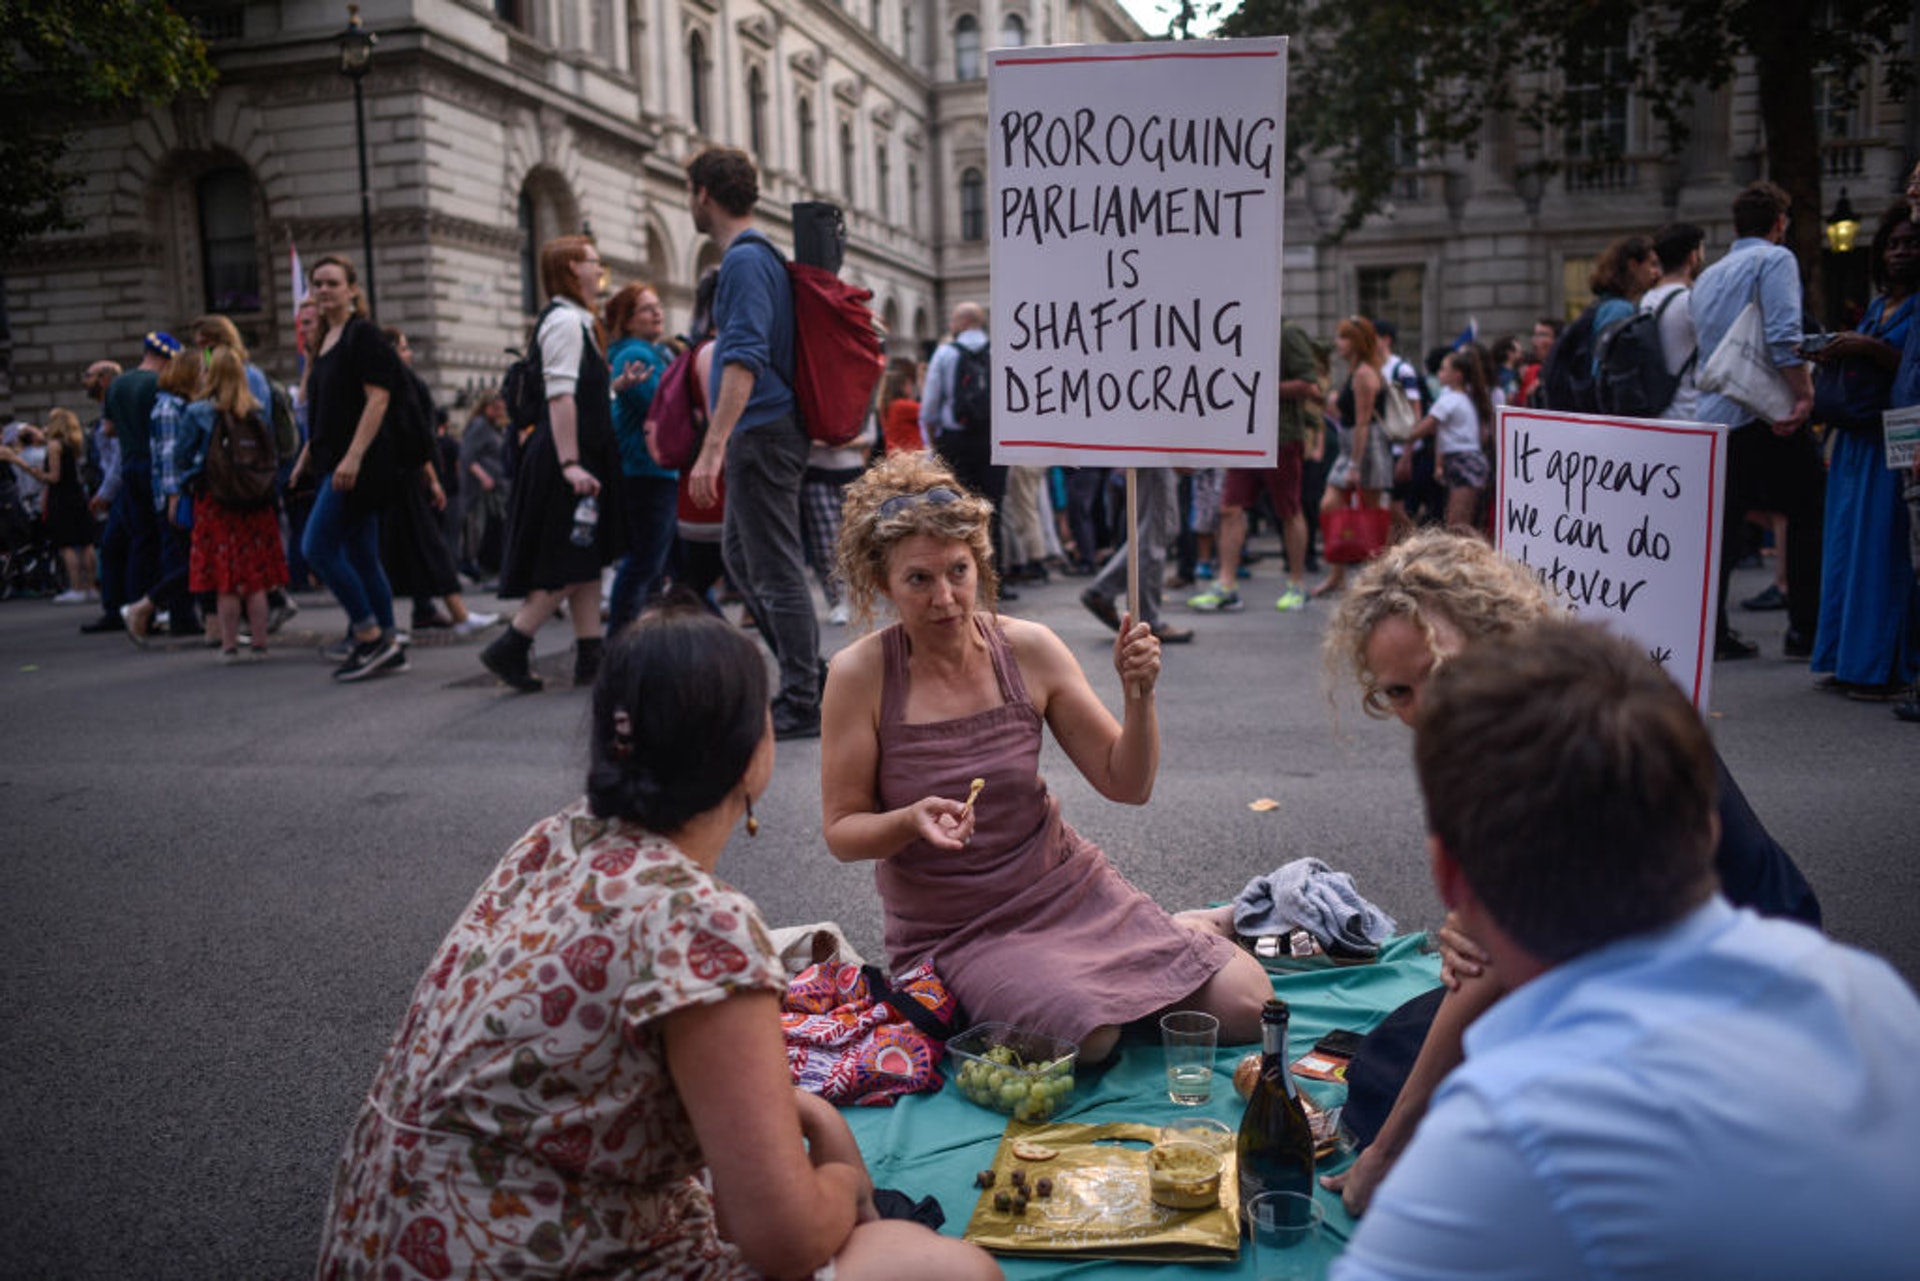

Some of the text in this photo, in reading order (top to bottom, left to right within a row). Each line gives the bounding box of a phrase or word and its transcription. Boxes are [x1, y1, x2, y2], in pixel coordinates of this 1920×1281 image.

[1000, 108, 1276, 178] PROROGUING
[1001, 184, 1266, 245] PARLIAMENT
[1107, 249, 1139, 289] IS
[1009, 298, 1242, 357] SHAFTING
[1004, 364, 1261, 434] DEMOCRACY
[1513, 430, 1681, 514] It appears
[1554, 513, 1608, 554] can
[1627, 515, 1670, 561] do
